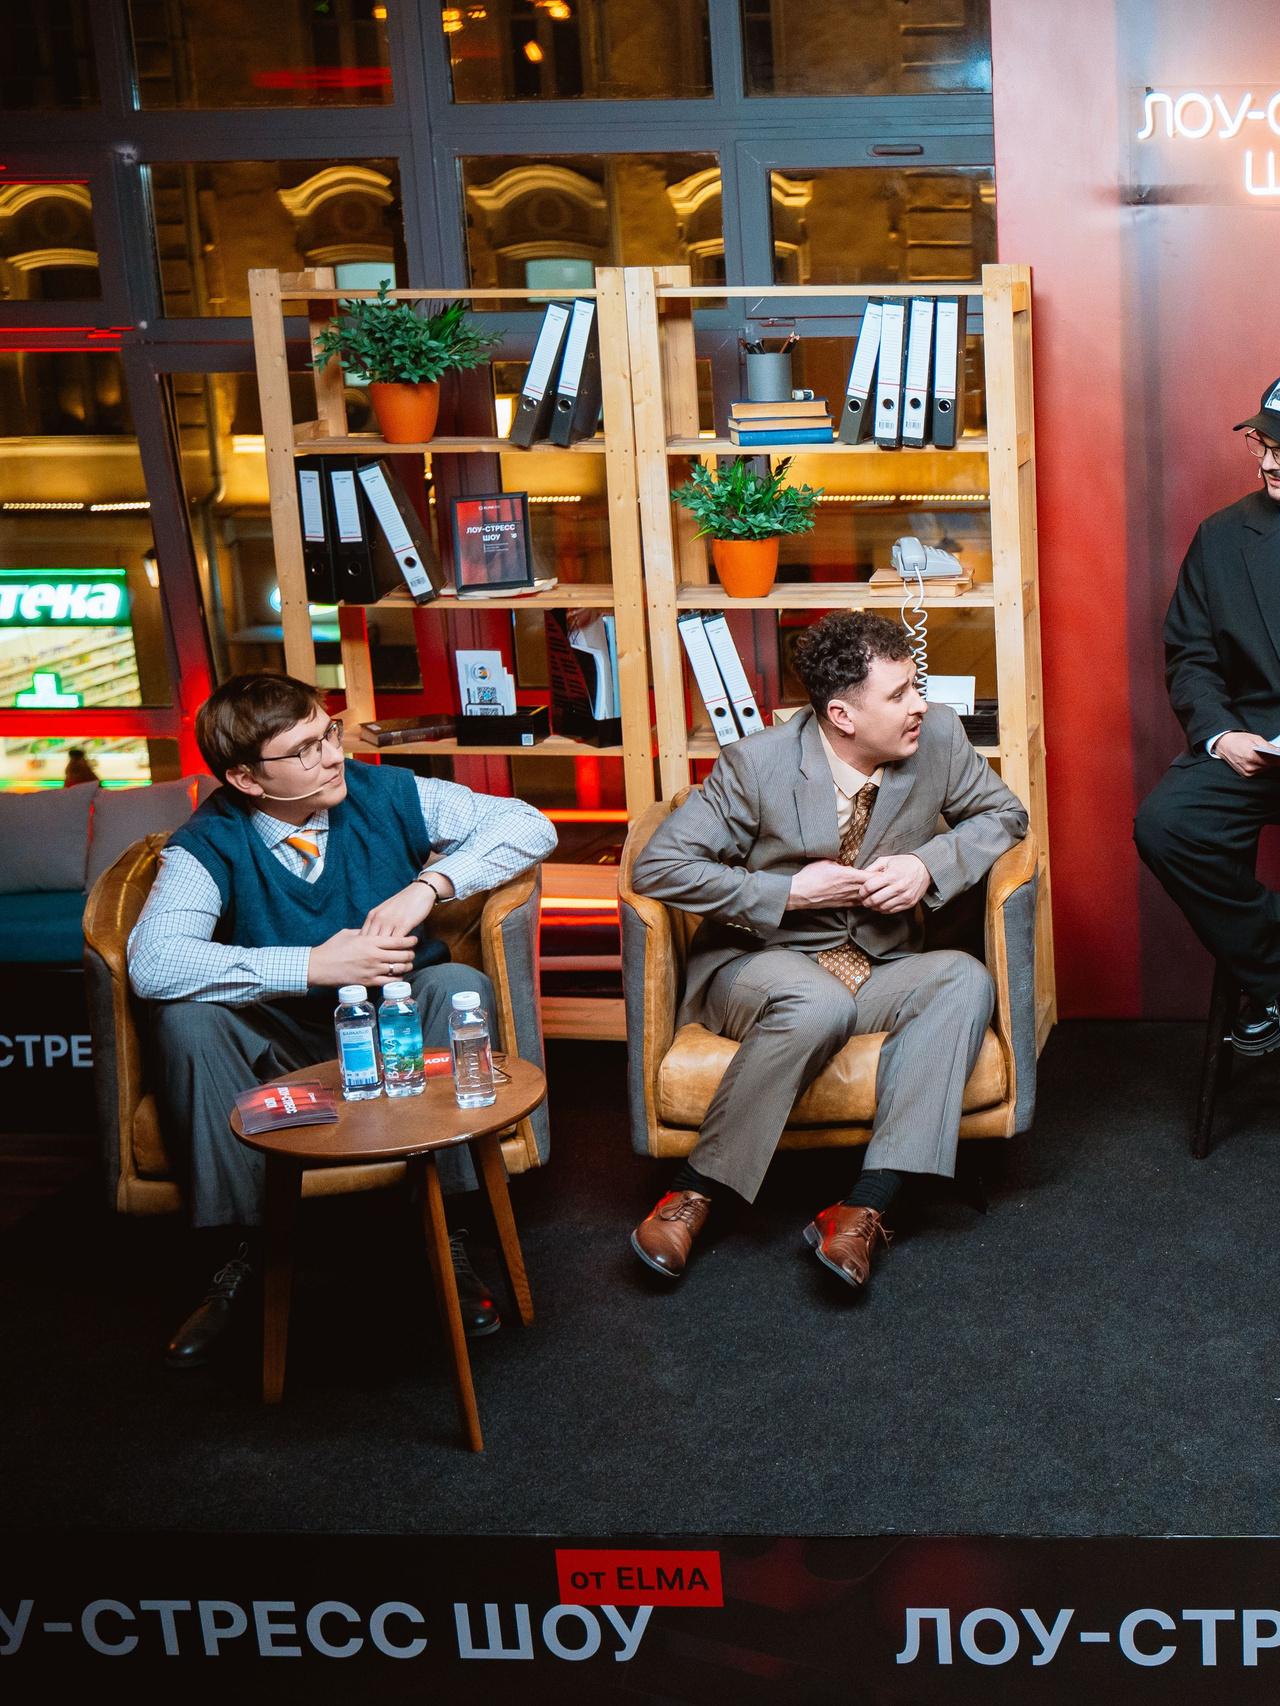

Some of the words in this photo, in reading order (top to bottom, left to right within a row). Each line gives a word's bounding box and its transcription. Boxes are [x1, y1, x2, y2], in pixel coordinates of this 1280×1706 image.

[466, 524, 516, 534] ЛОУ-СТРЕСС
[482, 534, 501, 542] ШОУ
[616, 1566, 710, 1591] ELMA
[454, 1602, 654, 1662] ШОУ
